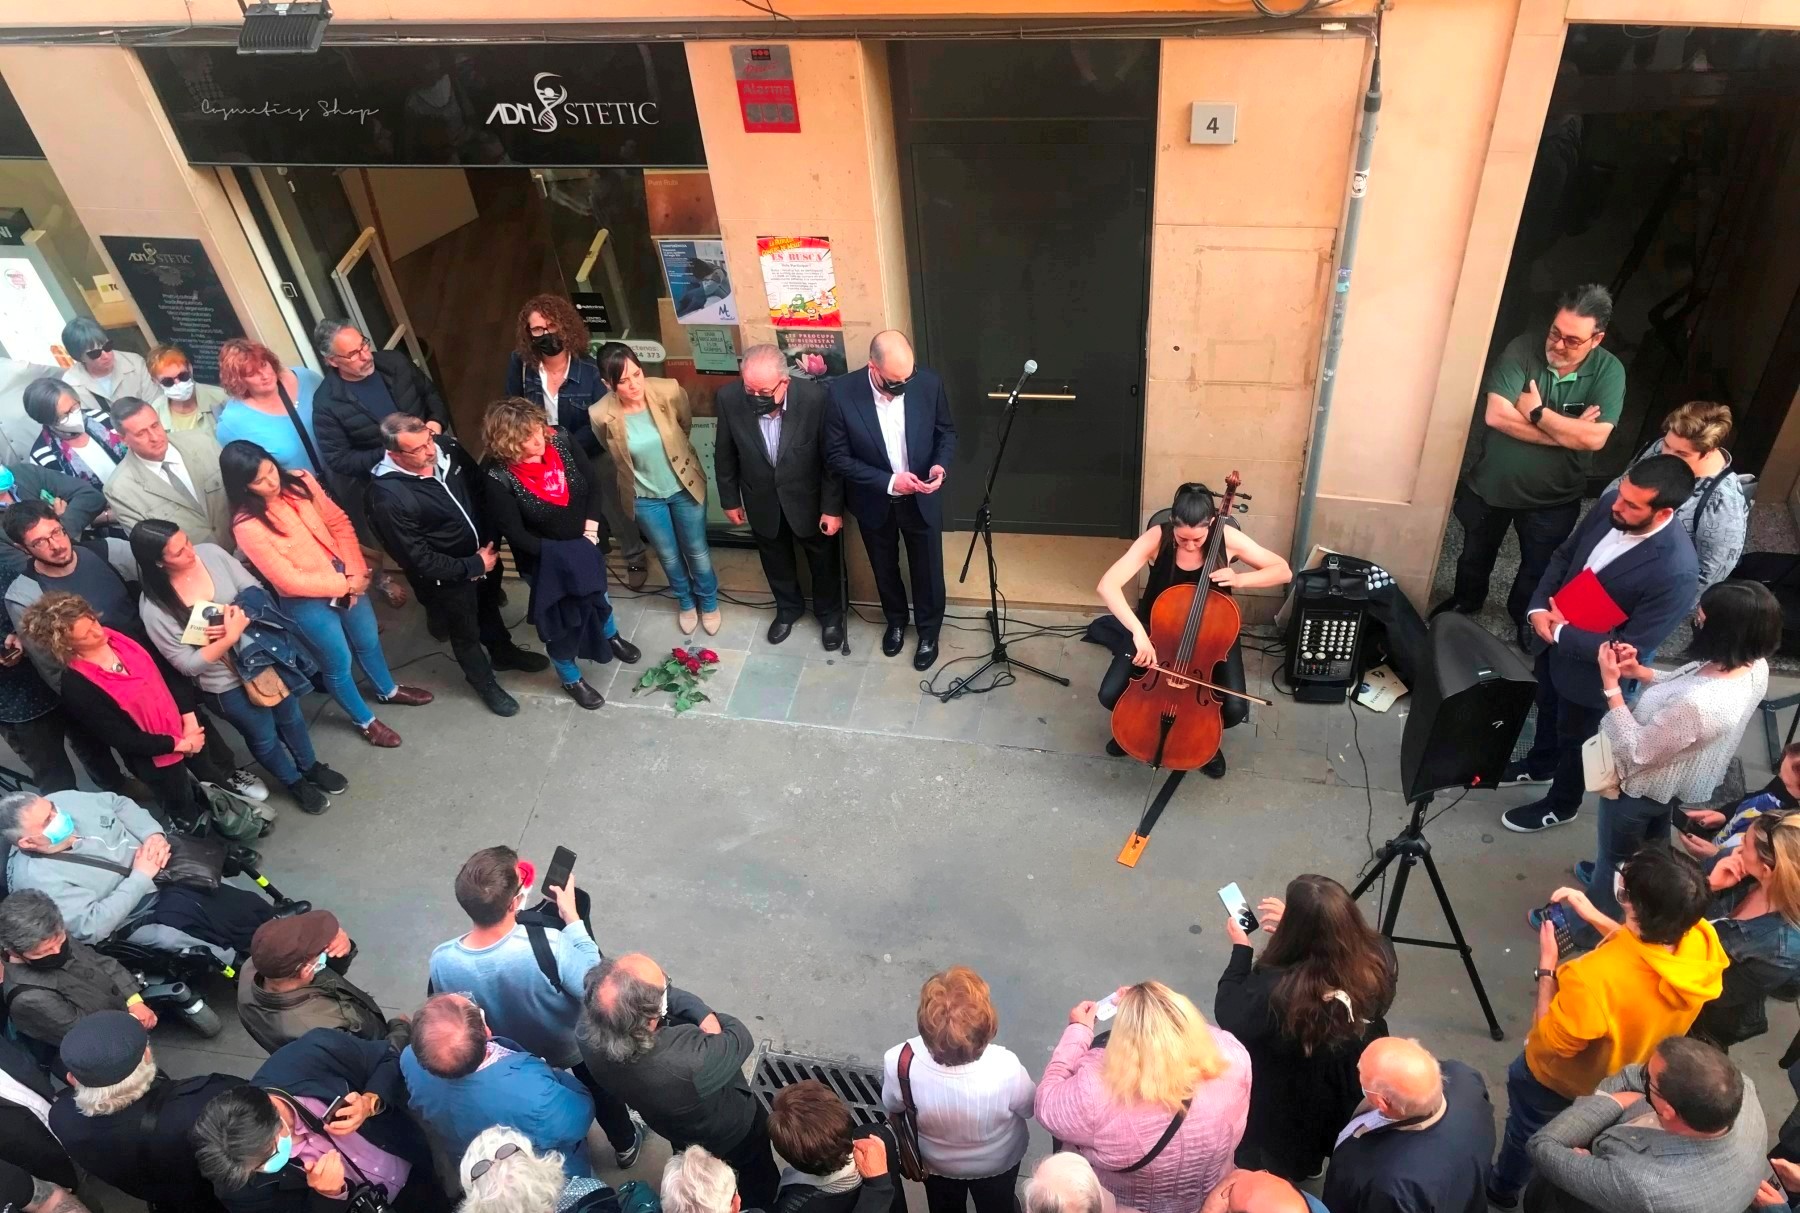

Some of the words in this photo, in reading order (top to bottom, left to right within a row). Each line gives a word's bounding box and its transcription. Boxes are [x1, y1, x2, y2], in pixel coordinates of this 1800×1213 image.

[317, 97, 380, 125] Shop
[1206, 116, 1220, 135] 4
[788, 253, 823, 262] BUSCA
